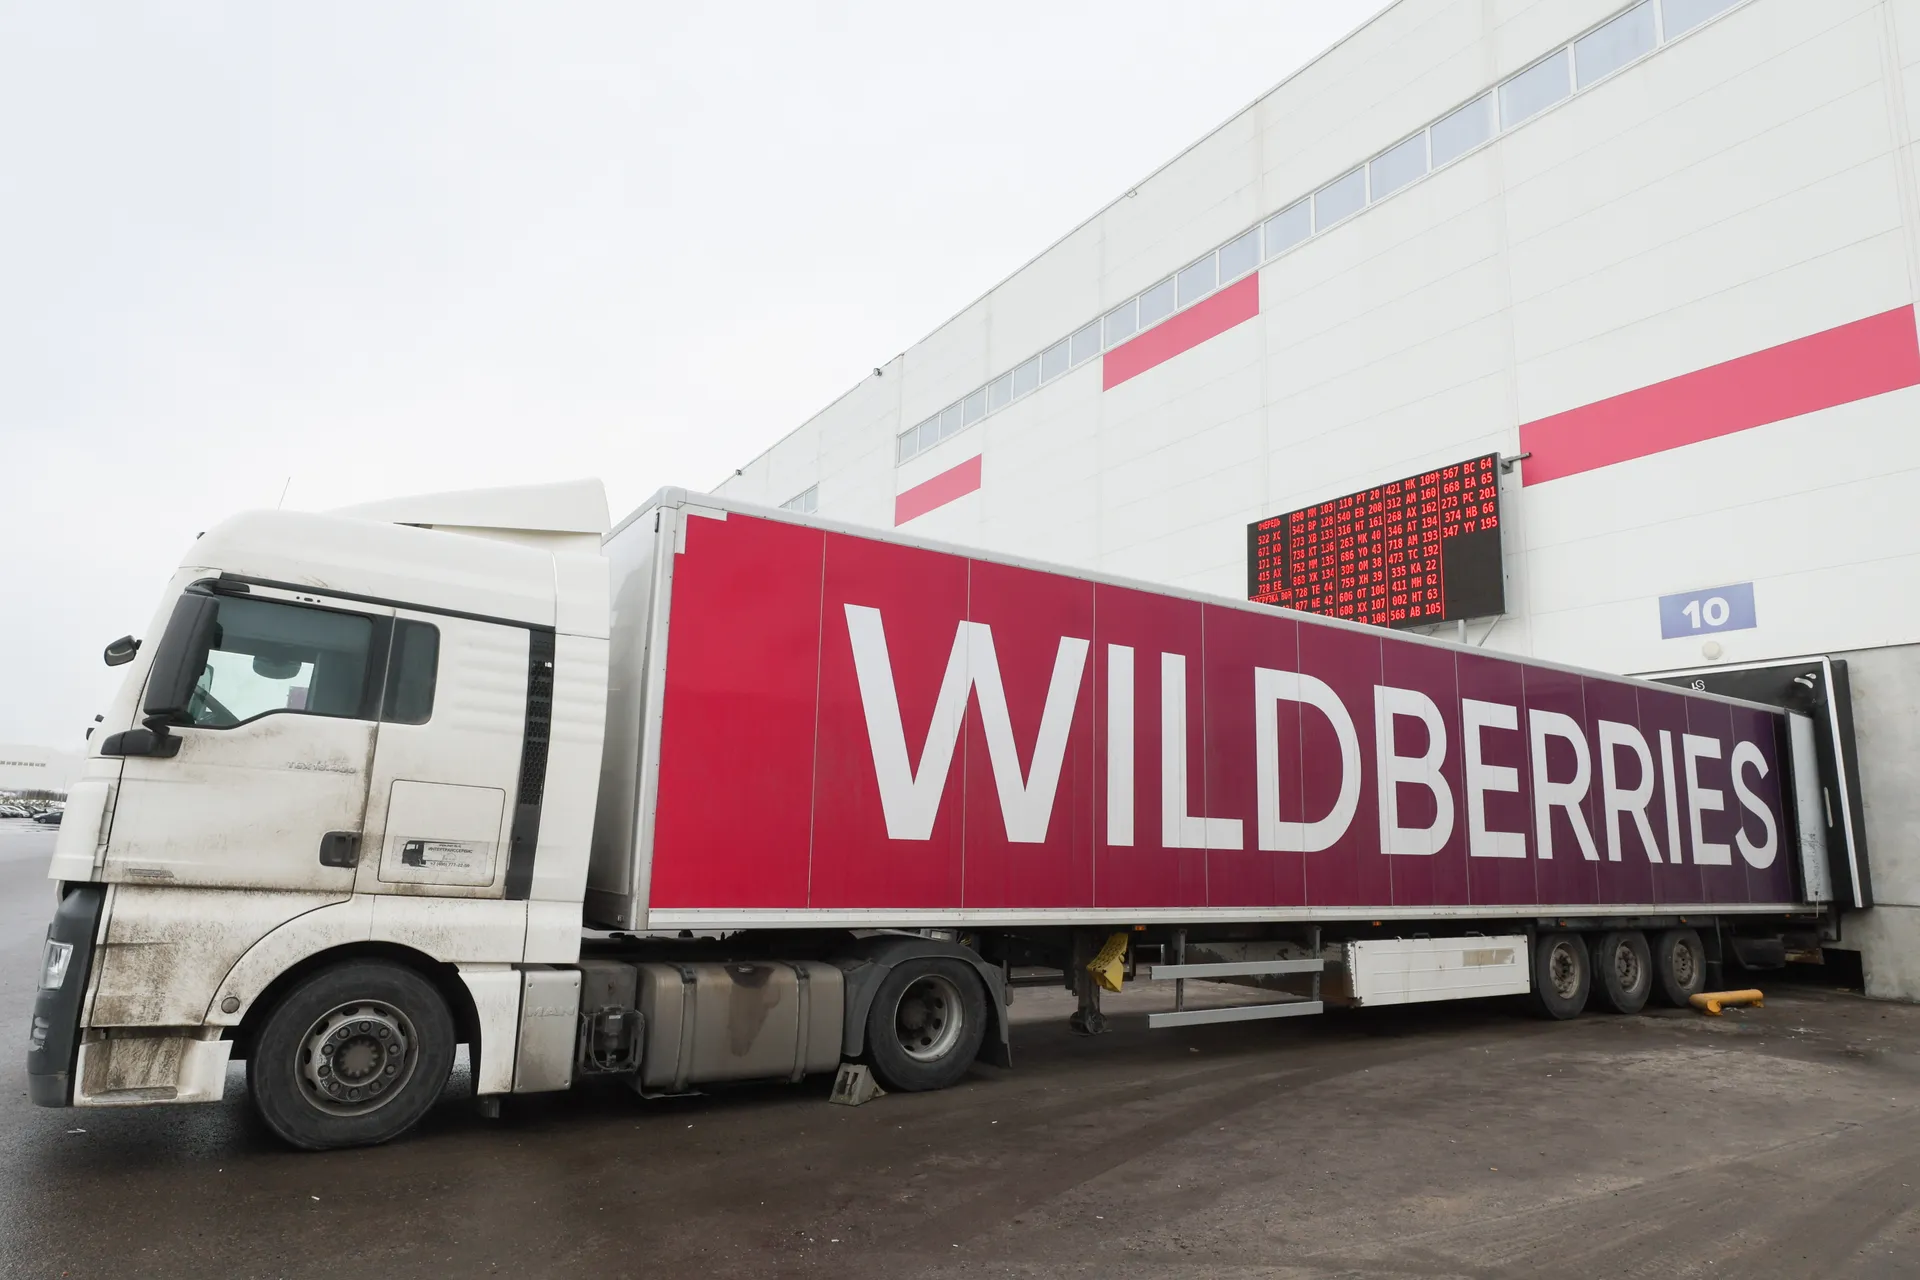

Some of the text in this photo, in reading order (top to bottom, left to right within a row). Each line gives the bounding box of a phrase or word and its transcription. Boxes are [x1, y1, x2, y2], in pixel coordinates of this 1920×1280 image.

[1443, 466, 1458, 480] 567
[1481, 457, 1492, 470] 64
[1386, 483, 1401, 495] 421
[1444, 481, 1460, 494] 668
[1481, 472, 1492, 484] 65
[1339, 497, 1353, 509] 110
[1370, 489, 1380, 500] 20
[1387, 497, 1401, 509] 312
[1421, 487, 1436, 500] 160
[1442, 496, 1457, 509] 273
[1479, 486, 1496, 500] 201
[1320, 503, 1333, 514] 103
[1337, 511, 1351, 523] 540
[1368, 502, 1382, 514] 208
[1387, 511, 1402, 523] 268
[1422, 502, 1436, 514] 162
[1445, 510, 1461, 523] 374
[1483, 502, 1494, 514] 66
[1258, 518, 1281, 531] ОЧЕРЕДЬ
[1293, 524, 1304, 535] 542
[1321, 516, 1333, 527] 128
[1338, 524, 1351, 536] 316
[1369, 516, 1382, 527] 161
[1388, 524, 1402, 536] 346
[1422, 516, 1437, 528] 194
[1443, 525, 1458, 537] 347
[1481, 516, 1497, 530] 195
[1258, 534, 1269, 545] 522
[1293, 537, 1304, 548] 273
[1321, 529, 1333, 540] 133
[1321, 542, 1334, 553] 136
[1340, 537, 1353, 548] 263
[1372, 530, 1381, 540] 40
[1388, 538, 1403, 550] 718
[1423, 530, 1438, 542] 193
[1258, 546, 1269, 557] 671
[1341, 550, 1354, 561] 686
[1372, 544, 1381, 554] 43
[1389, 553, 1403, 564] 473
[1423, 544, 1438, 557] 192
[1258, 559, 1269, 569] 171
[1293, 562, 1305, 573] 752
[1322, 555, 1334, 566] 135
[1341, 564, 1354, 575] 309
[1372, 557, 1382, 568] 38
[1392, 566, 1406, 578] 335
[1426, 559, 1436, 571] 22
[1258, 571, 1270, 581] 415
[1322, 568, 1334, 579] 134
[1341, 577, 1354, 588] 759
[1373, 571, 1382, 581] 39
[1259, 583, 1270, 594] 728
[1296, 587, 1308, 598] 728
[1324, 582, 1333, 592] 44
[1392, 580, 1407, 592] 411
[1427, 574, 1437, 585] 62
[1324, 595, 1333, 605] 42
[1340, 591, 1353, 602] 606
[1371, 584, 1385, 596] 106
[1393, 594, 1407, 606] 002
[1427, 589, 1437, 599] 63
[1340, 605, 1353, 616] 608
[1372, 598, 1385, 610] 107
[1391, 609, 1405, 620] 568
[1426, 602, 1441, 614] 105
[1682, 597, 1729, 629] 10
[1372, 612, 1386, 624] 108
[844, 604, 1778, 869] WILDBERRIES
